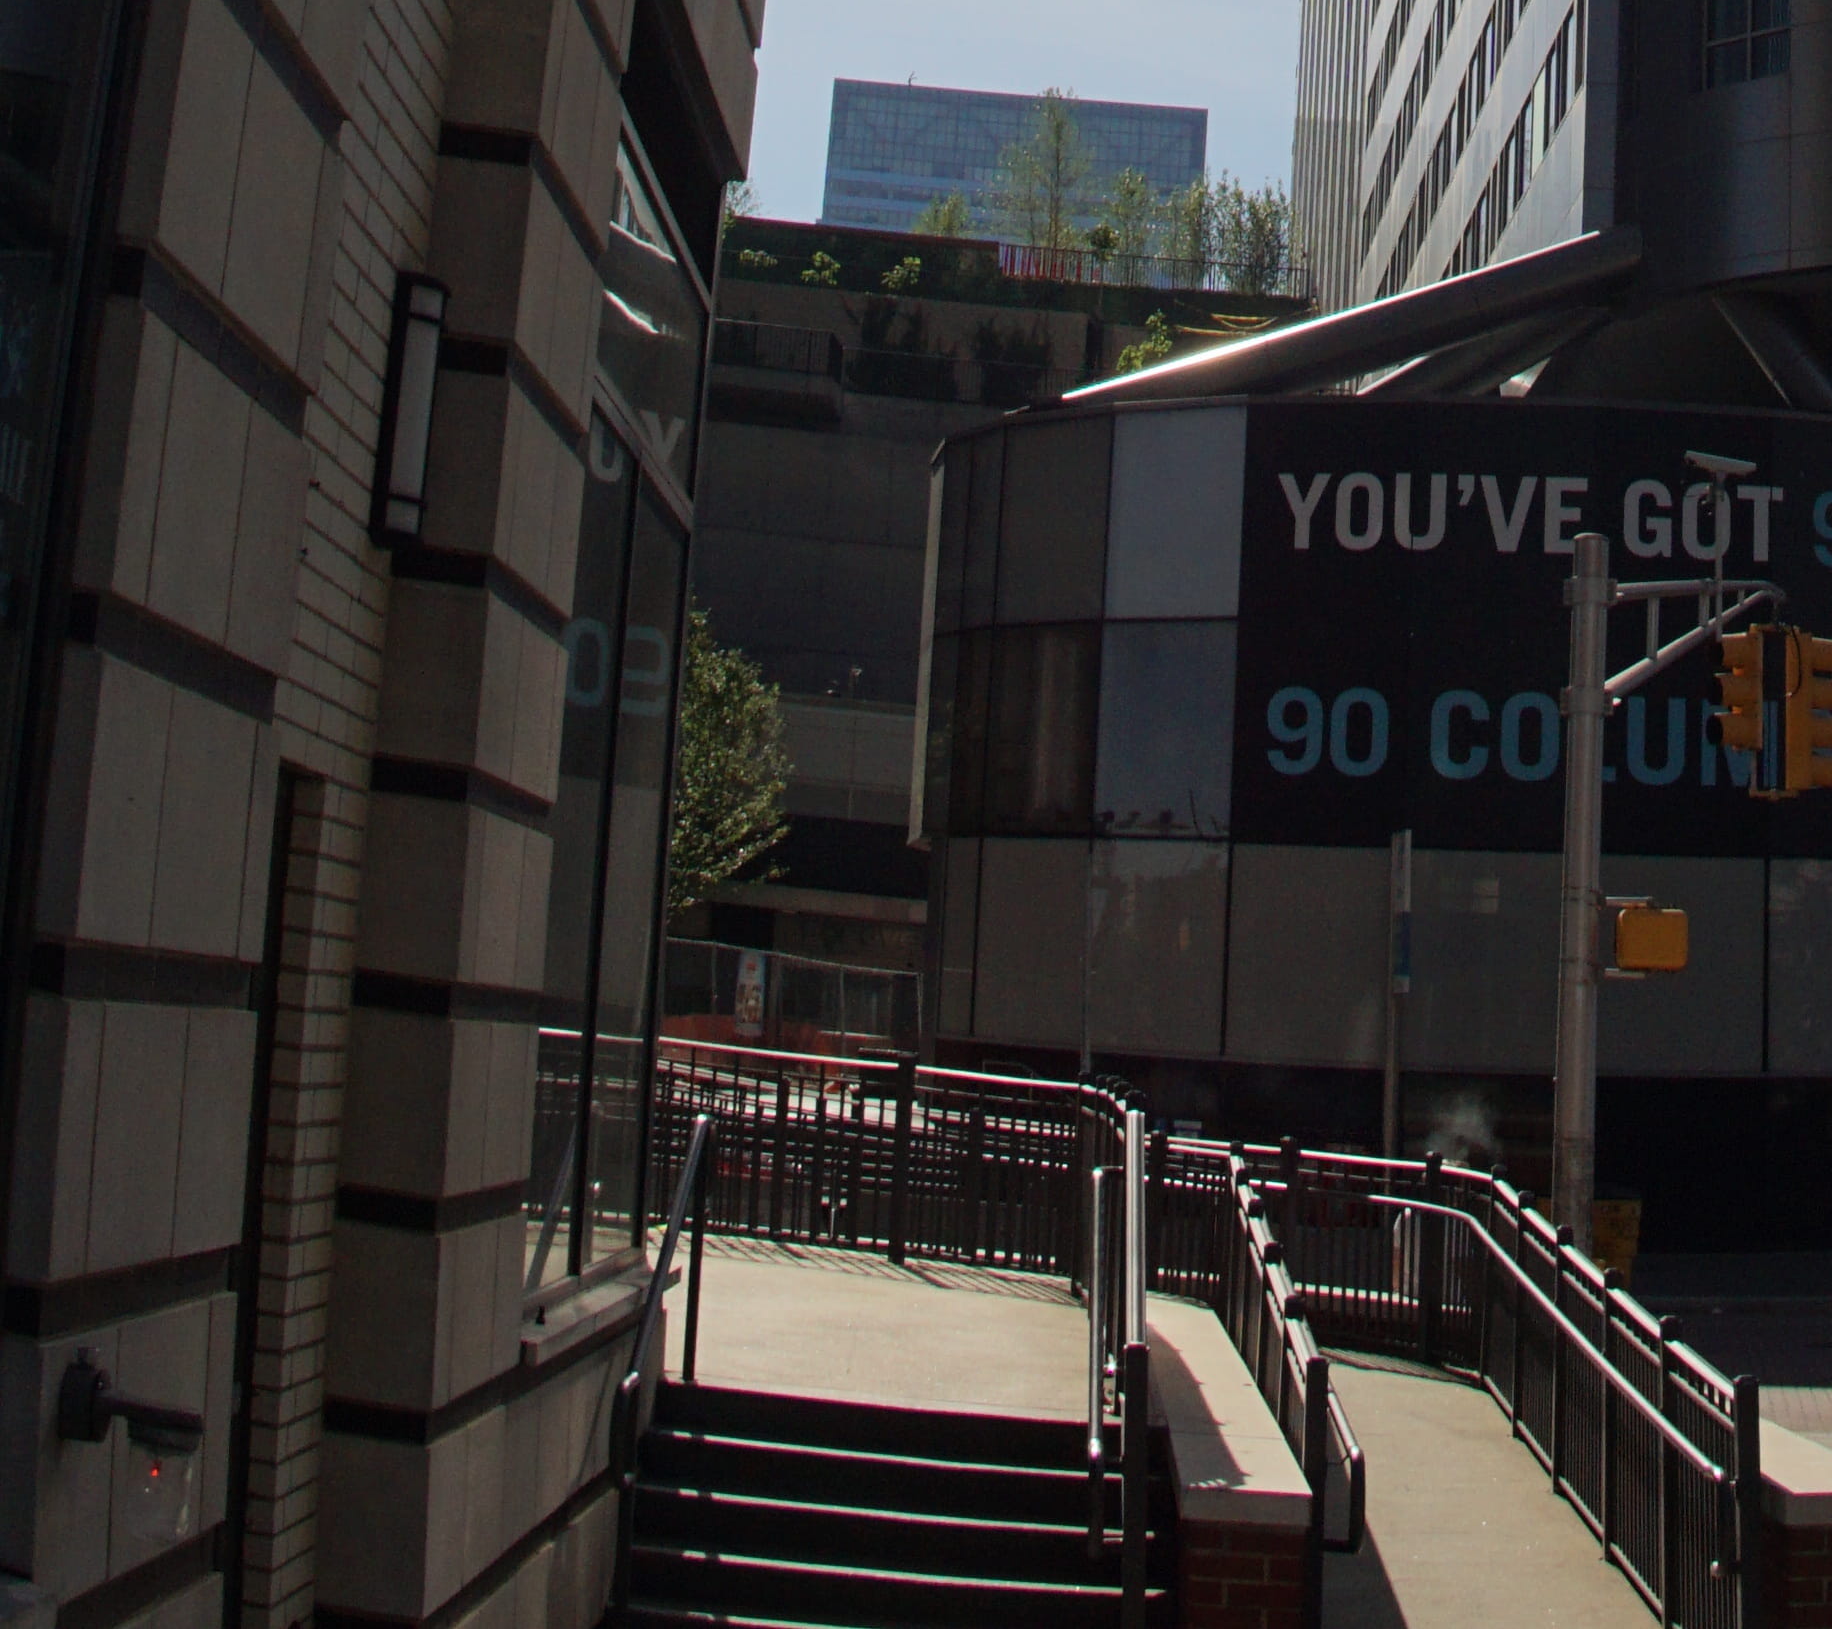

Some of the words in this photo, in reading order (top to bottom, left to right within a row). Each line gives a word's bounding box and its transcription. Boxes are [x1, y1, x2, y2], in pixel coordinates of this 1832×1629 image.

[1277, 471, 1590, 556] YOU'VE
[1623, 479, 1784, 564] GOT
[1266, 686, 1390, 777] 90
